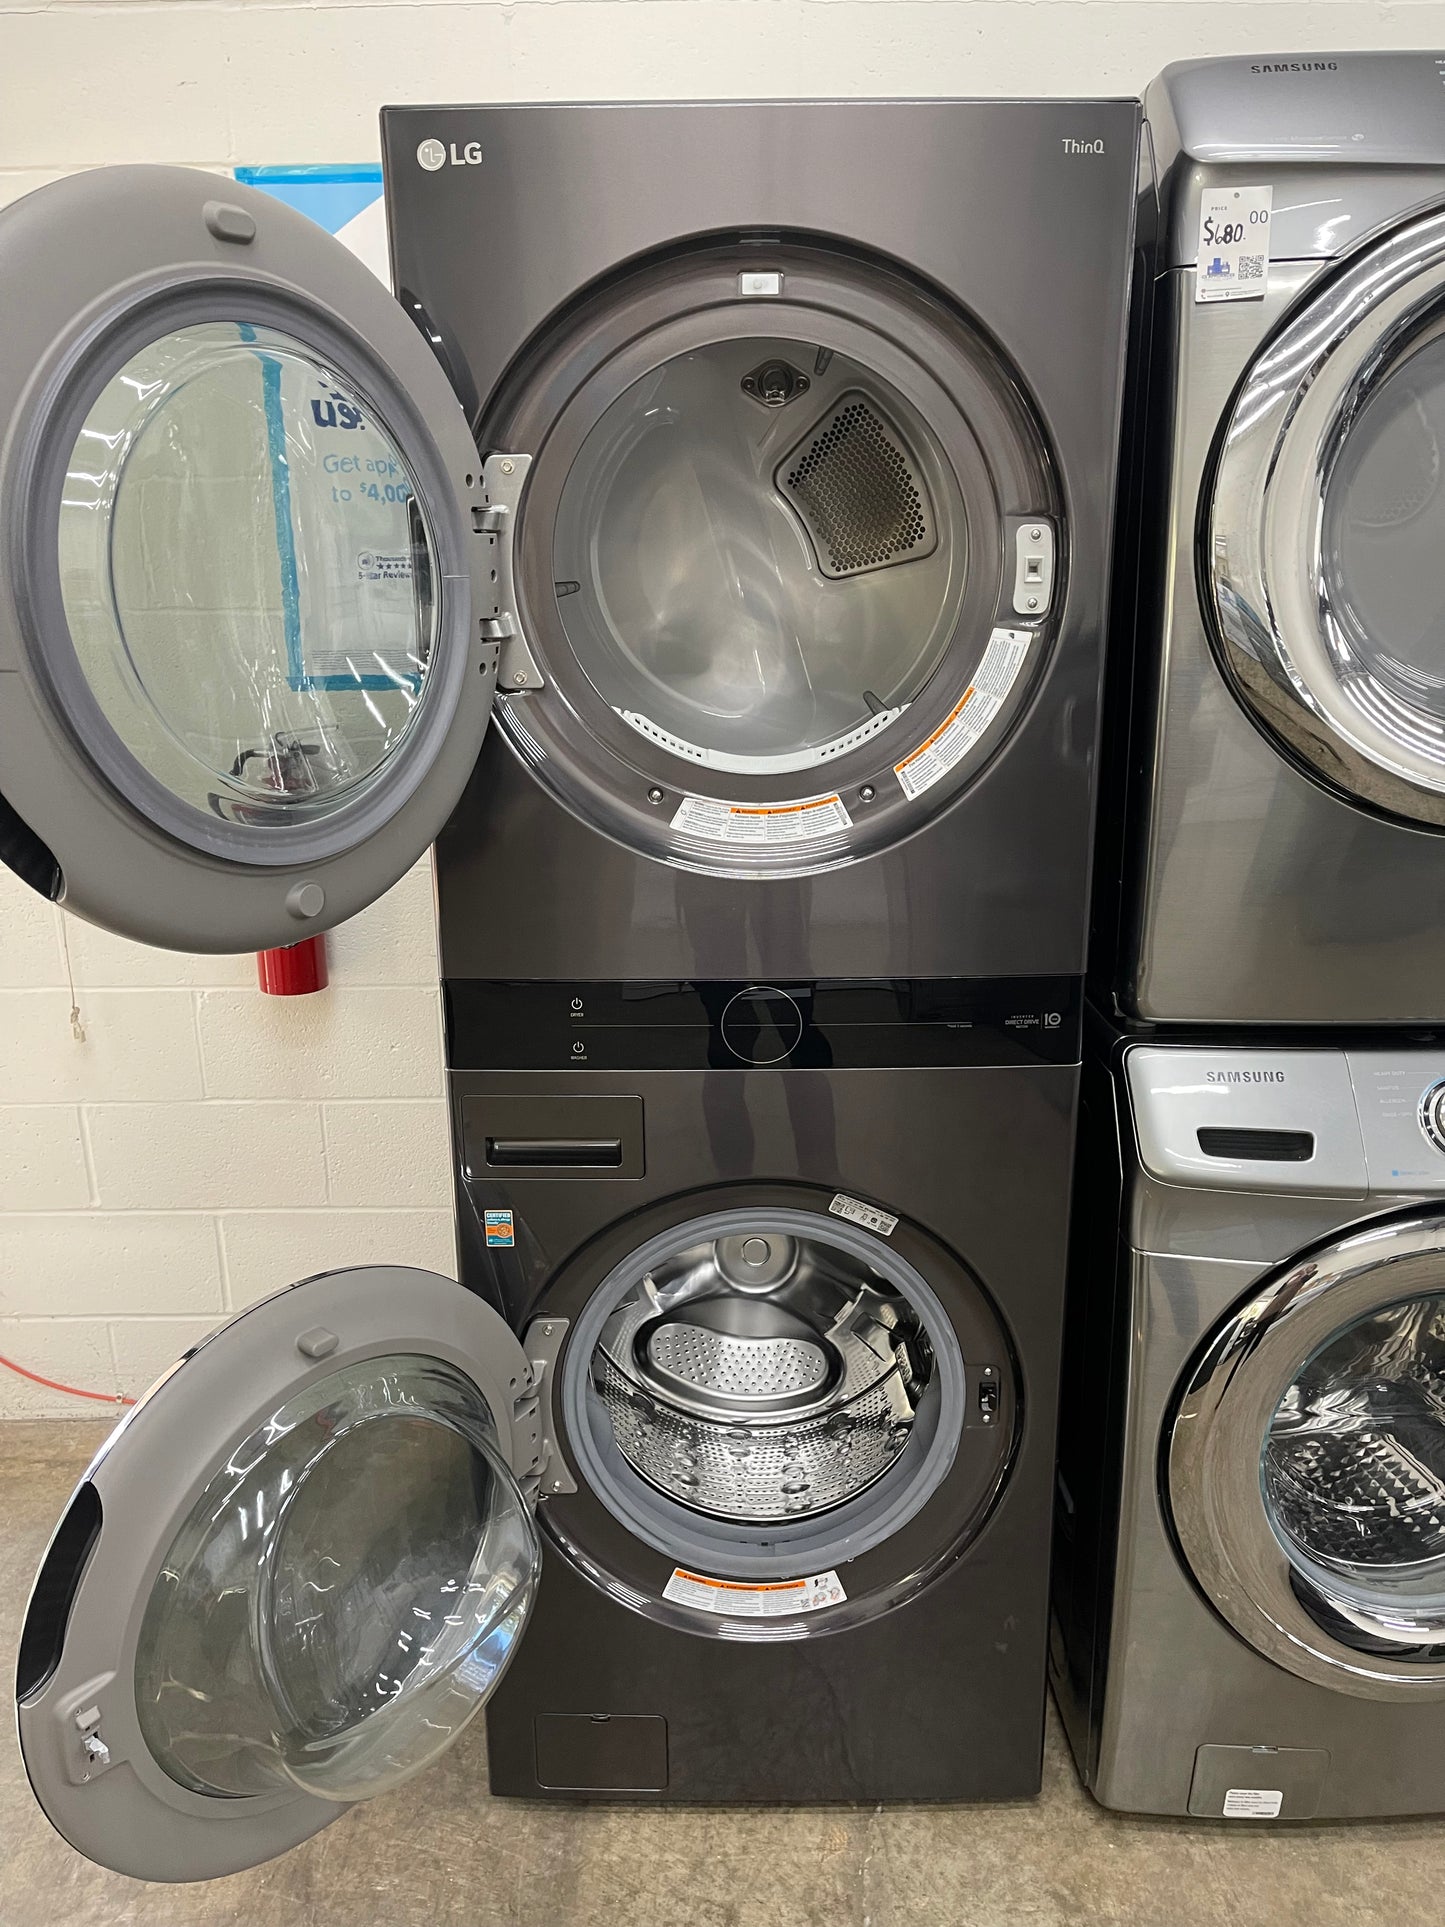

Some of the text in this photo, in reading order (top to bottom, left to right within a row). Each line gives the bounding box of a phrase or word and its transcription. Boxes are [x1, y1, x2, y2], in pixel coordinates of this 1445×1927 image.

[1251, 63, 1338, 74] SAMSUNG
[449, 142, 483, 165] LG
[1062, 139, 1105, 154] ThinQ
[1249, 210, 1268, 224] 00
[323, 454, 362, 473] Get
[332, 486, 352, 503] to
[1206, 1071, 1285, 1083] SAMSUNG
